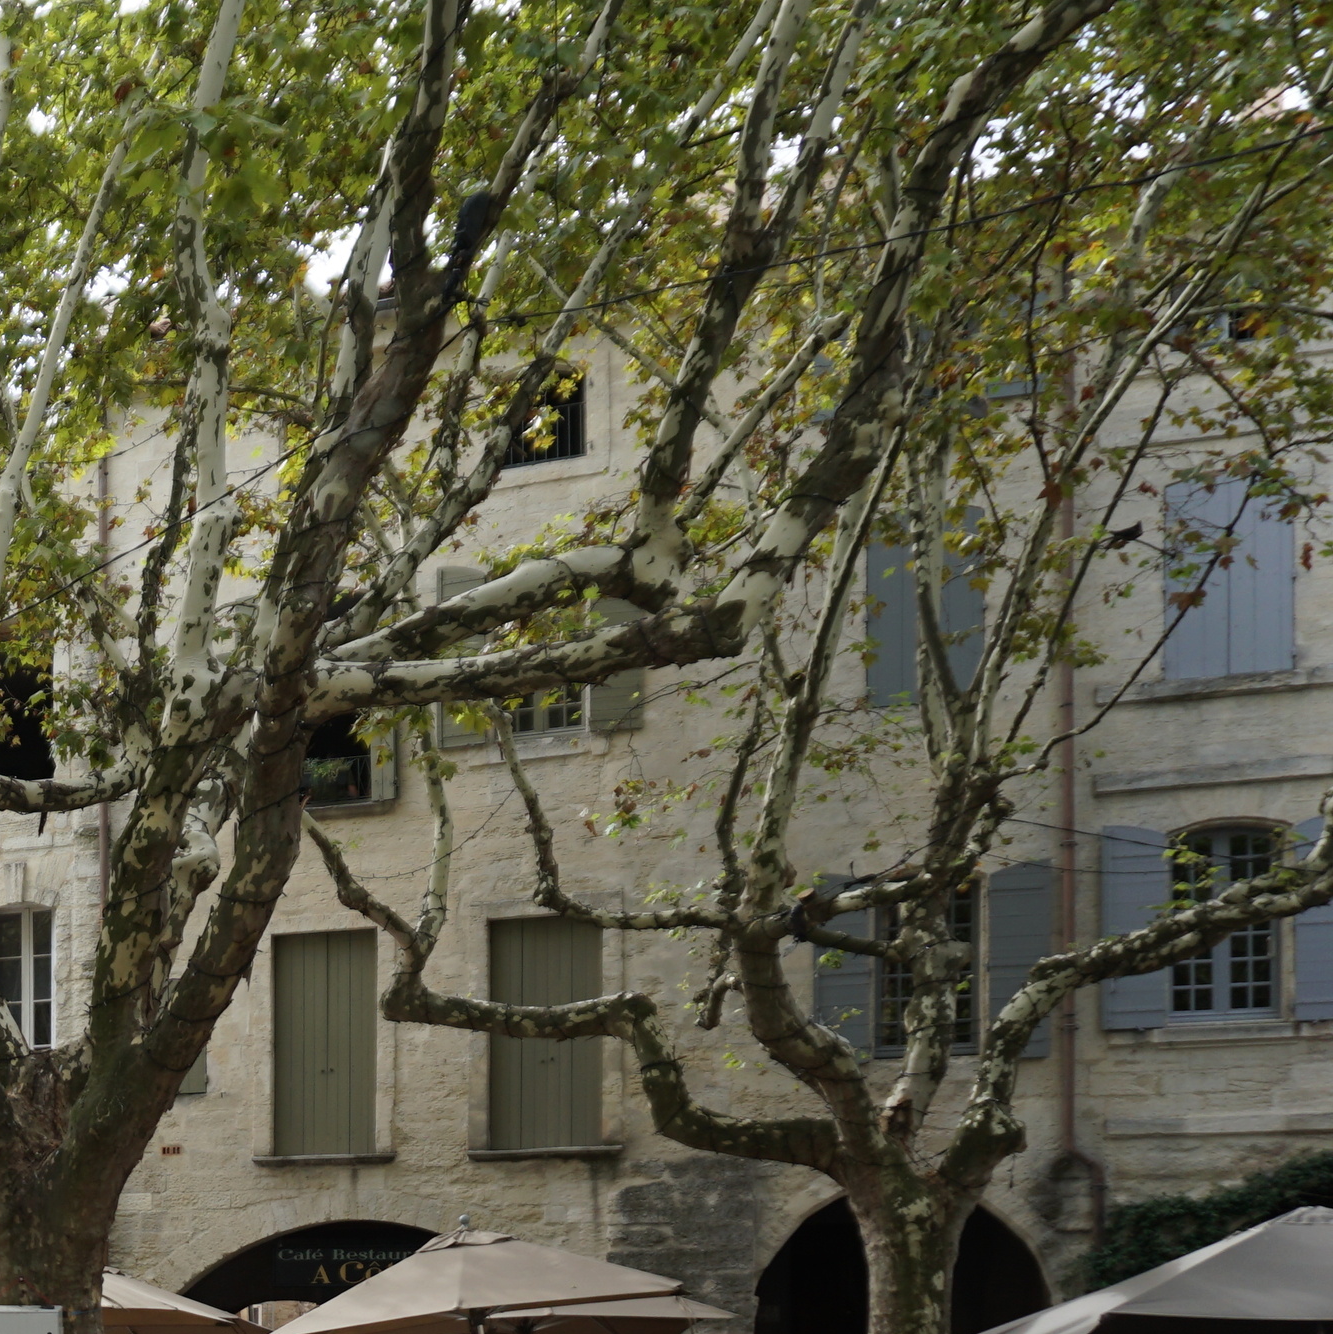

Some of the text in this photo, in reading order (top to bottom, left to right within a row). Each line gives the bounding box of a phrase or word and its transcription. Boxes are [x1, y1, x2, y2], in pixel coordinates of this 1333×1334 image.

[278, 1249, 323, 1261] Café
[310, 1260, 393, 1284] A Cô
